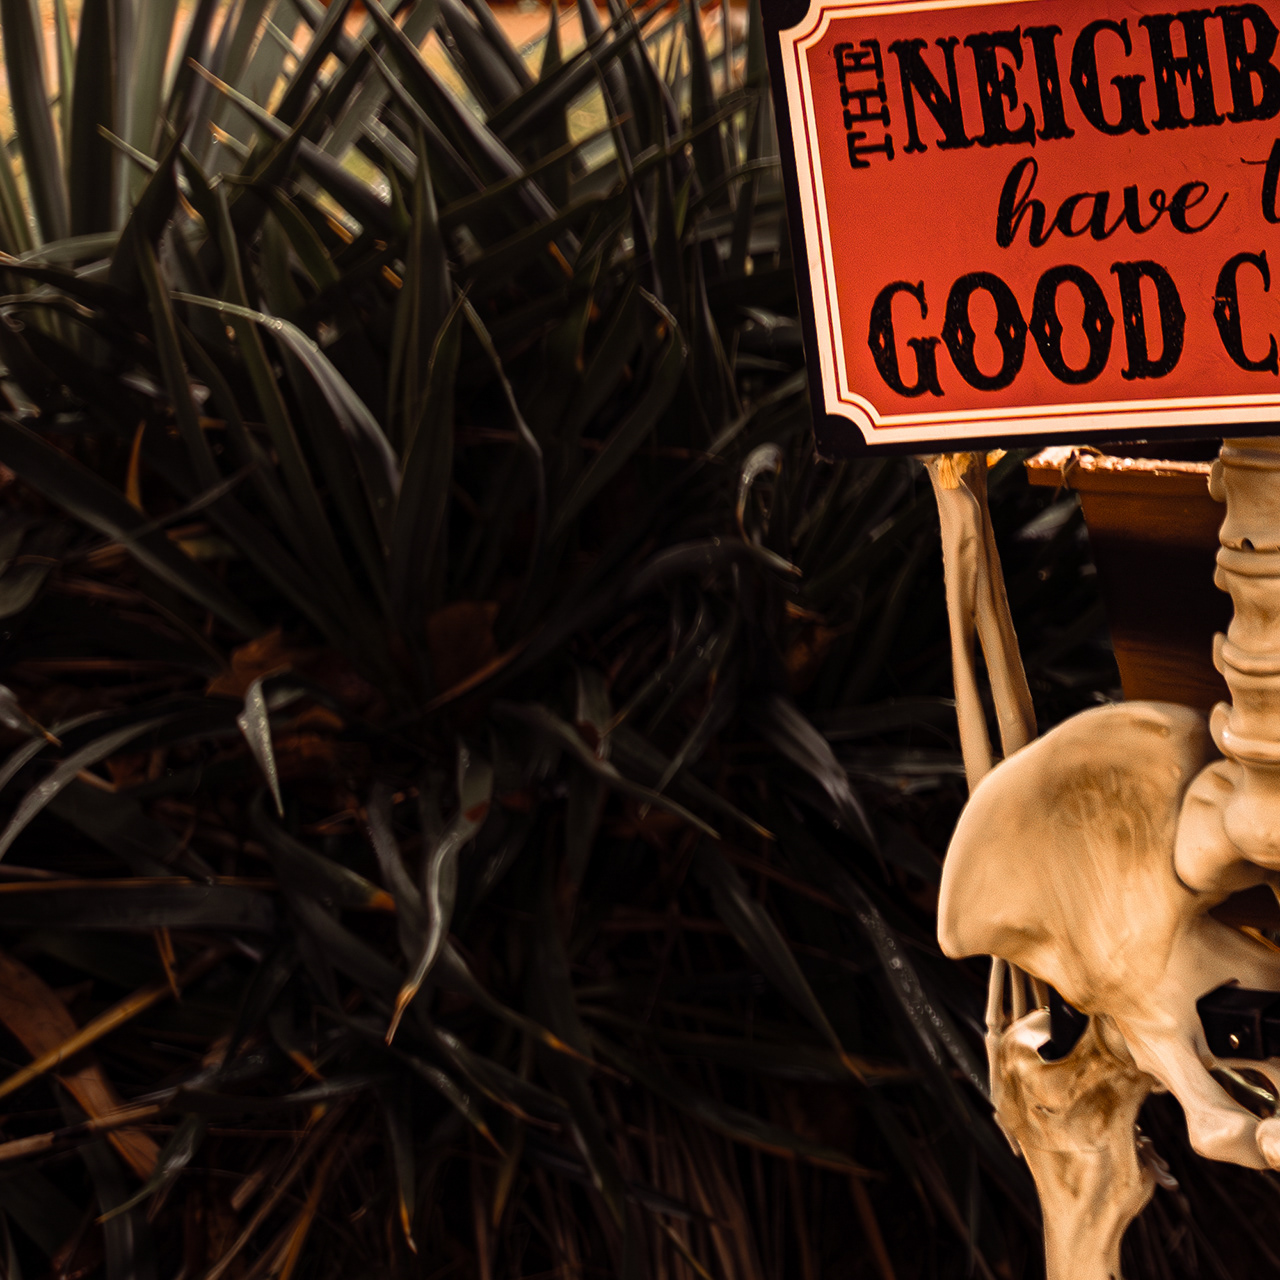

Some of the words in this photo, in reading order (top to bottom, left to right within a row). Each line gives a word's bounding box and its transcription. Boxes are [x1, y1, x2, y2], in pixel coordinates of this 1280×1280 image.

[836, 38, 895, 169] THE
[995, 156, 1229, 248] have
[867, 260, 1187, 398] GOOD
